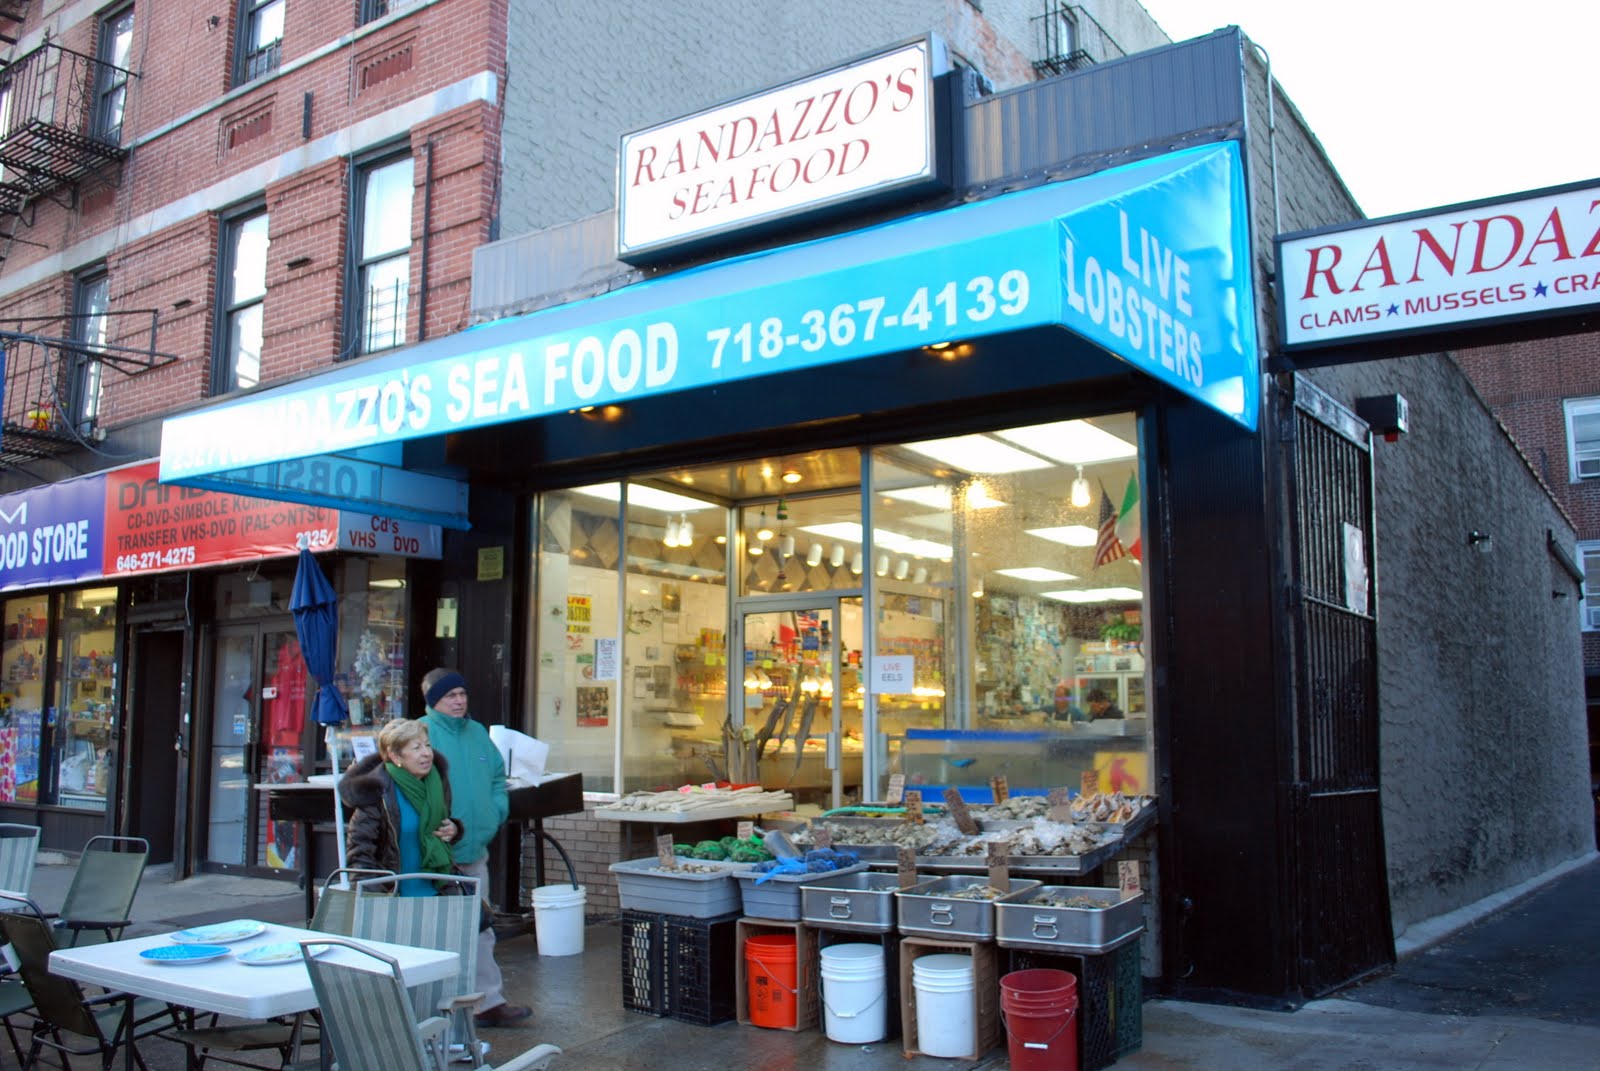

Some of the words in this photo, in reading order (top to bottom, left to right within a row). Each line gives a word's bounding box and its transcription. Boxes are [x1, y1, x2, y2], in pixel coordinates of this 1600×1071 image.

[632, 67, 917, 187] RANDAZZO'S
[669, 139, 870, 220] SEAFOOD
[1119, 208, 1192, 317] LIVE
[1065, 236, 1203, 388] LOBSTERS
[1300, 304, 1380, 330] CLAMS
[1405, 283, 1526, 315] MUSSELS
[446, 352, 529, 423] SEA
[544, 322, 679, 405] FOOD
[706, 269, 1030, 369] 718-367-4139
[32, 519, 89, 566] STORE
[117, 528, 177, 551] TRANSFER
[182, 519, 237, 542] VHS-DVD
[350, 530, 376, 548] VHS
[394, 536, 419, 554] DVD
[370, 516, 399, 533] Cd's
[116, 546, 195, 571] 646-271-4275
[881, 673, 903, 682] EELS
[882, 663, 901, 671] LIVE
